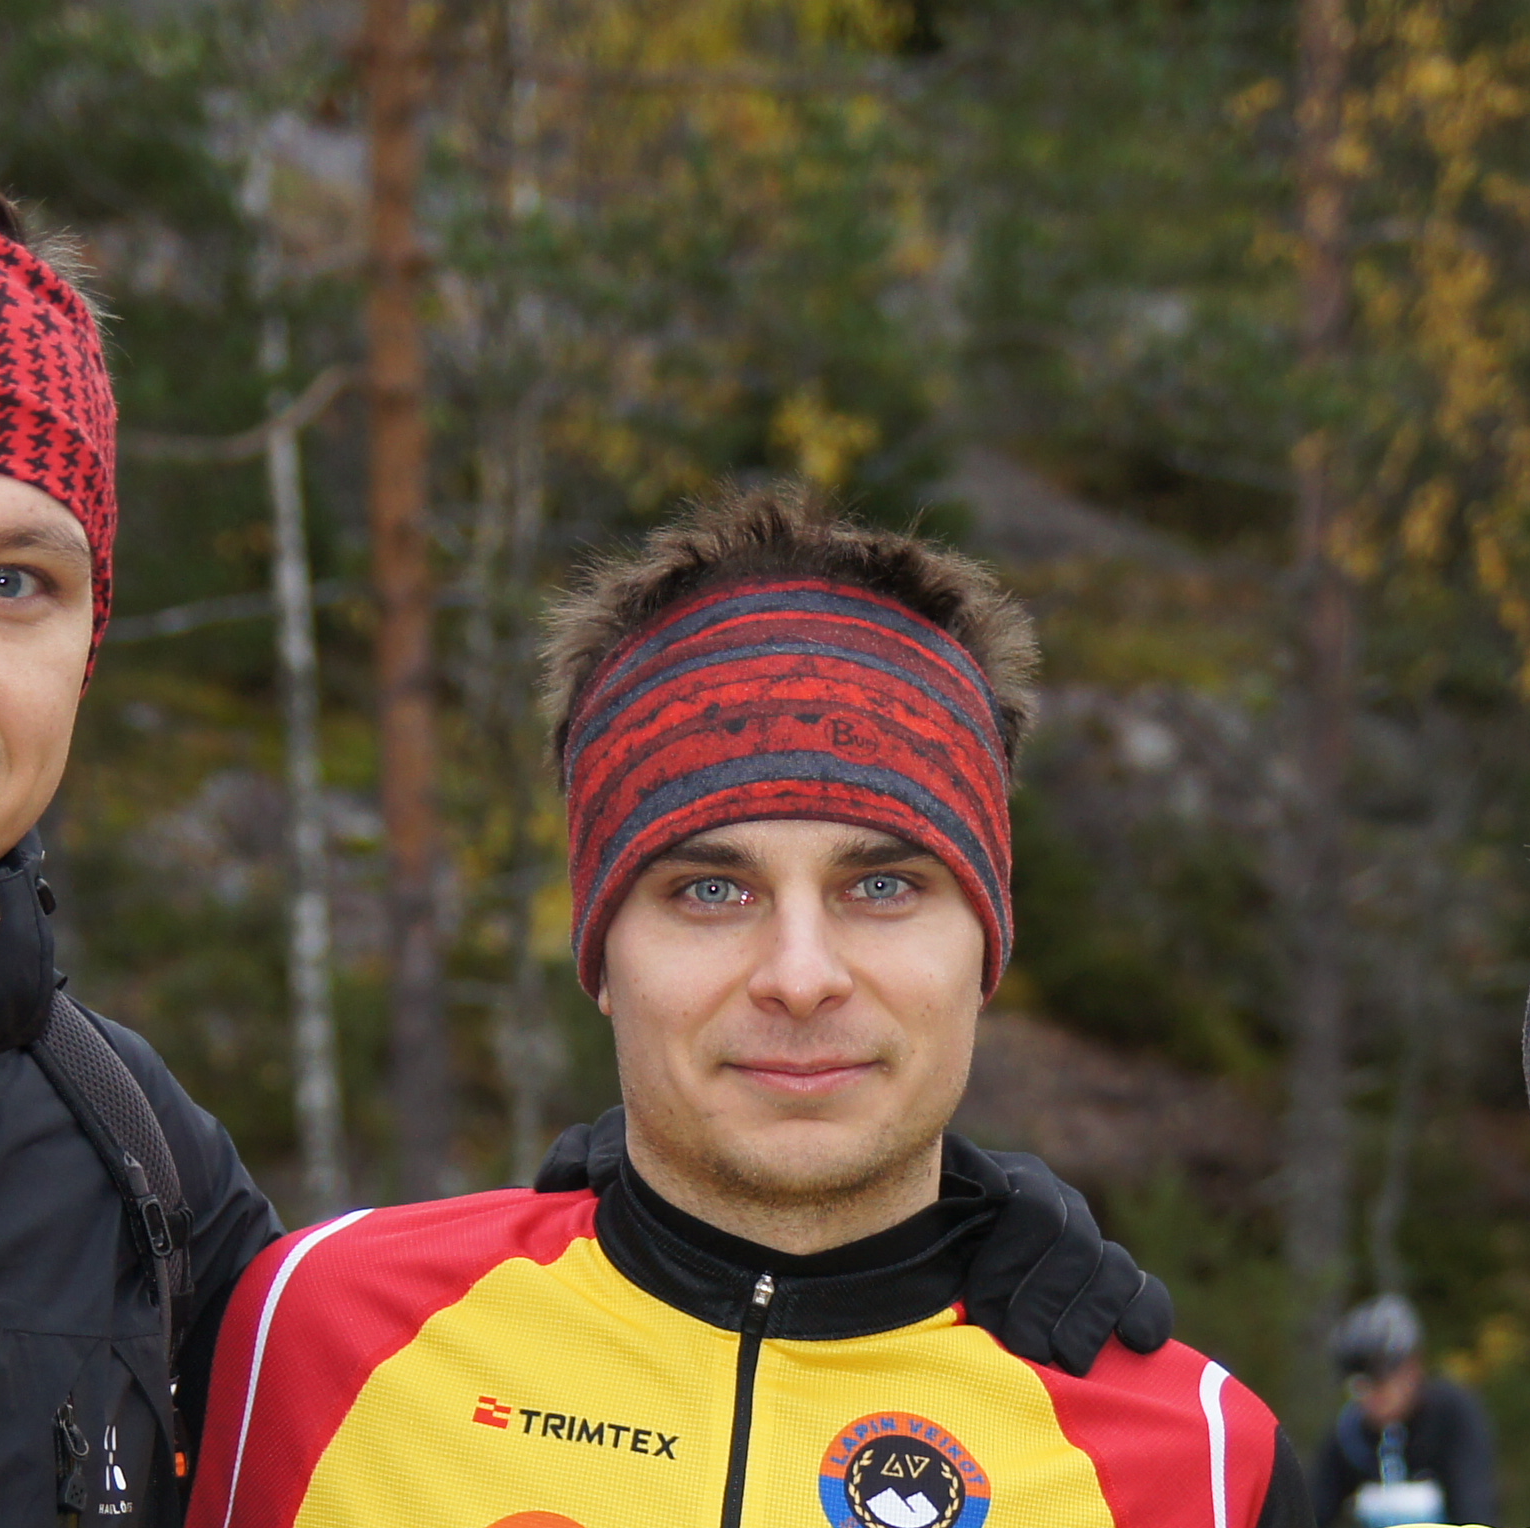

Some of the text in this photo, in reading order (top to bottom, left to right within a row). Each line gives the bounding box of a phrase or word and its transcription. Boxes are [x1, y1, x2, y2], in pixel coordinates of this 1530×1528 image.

[519, 1408, 680, 1460] TRIMTEX
[830, 1416, 985, 1486] LAPIN VEIKOT
